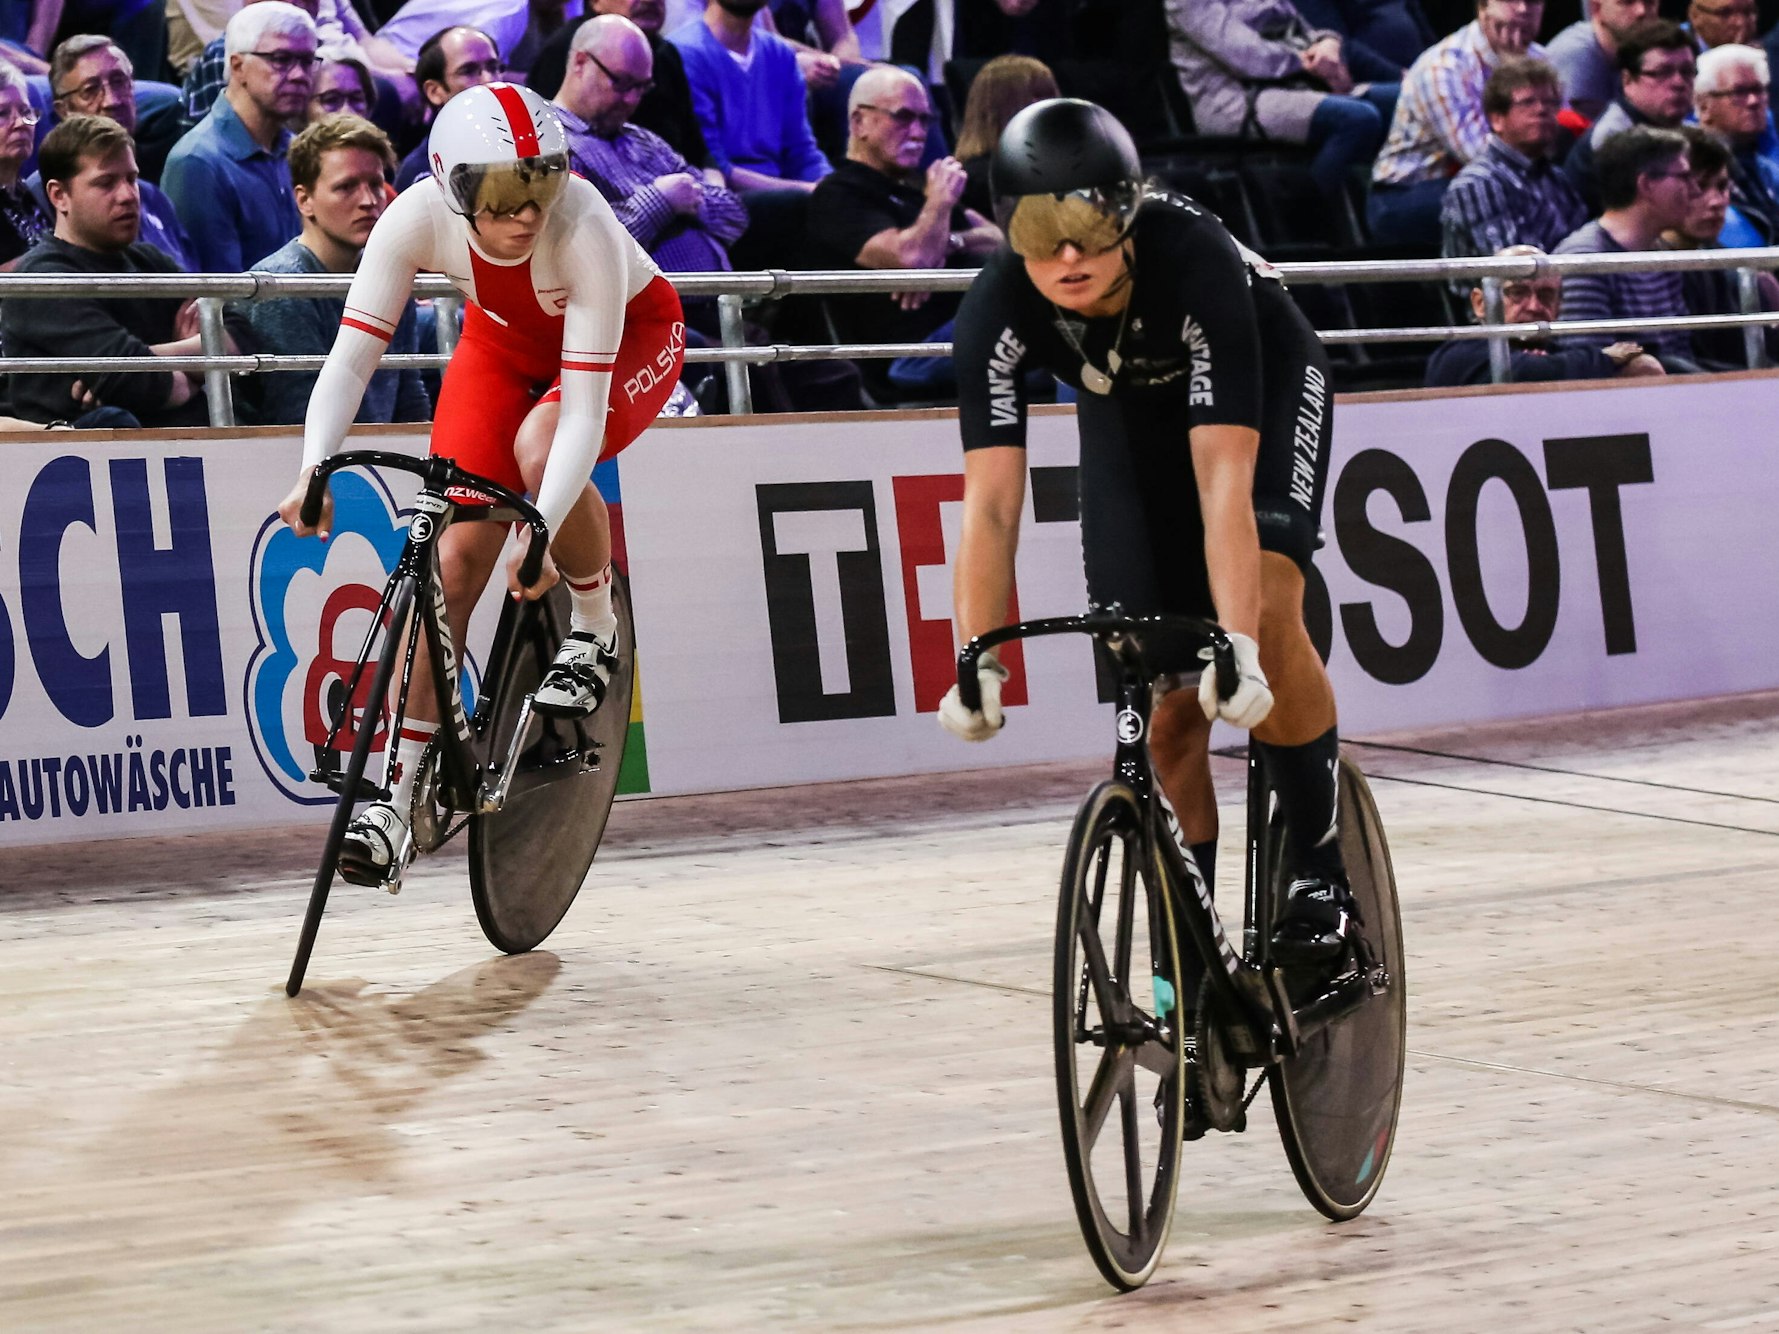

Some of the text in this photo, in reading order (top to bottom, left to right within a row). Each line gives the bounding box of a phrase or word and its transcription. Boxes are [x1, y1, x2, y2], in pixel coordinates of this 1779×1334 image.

[623, 321, 685, 404] POLSKA
[988, 327, 1026, 427] VANTAGE
[1181, 314, 1213, 406] VANTAGE
[1289, 365, 1326, 511] NEW ZEALAND
[0, 455, 227, 728] CH
[0, 734, 236, 822] AUTOWÄSCHE
